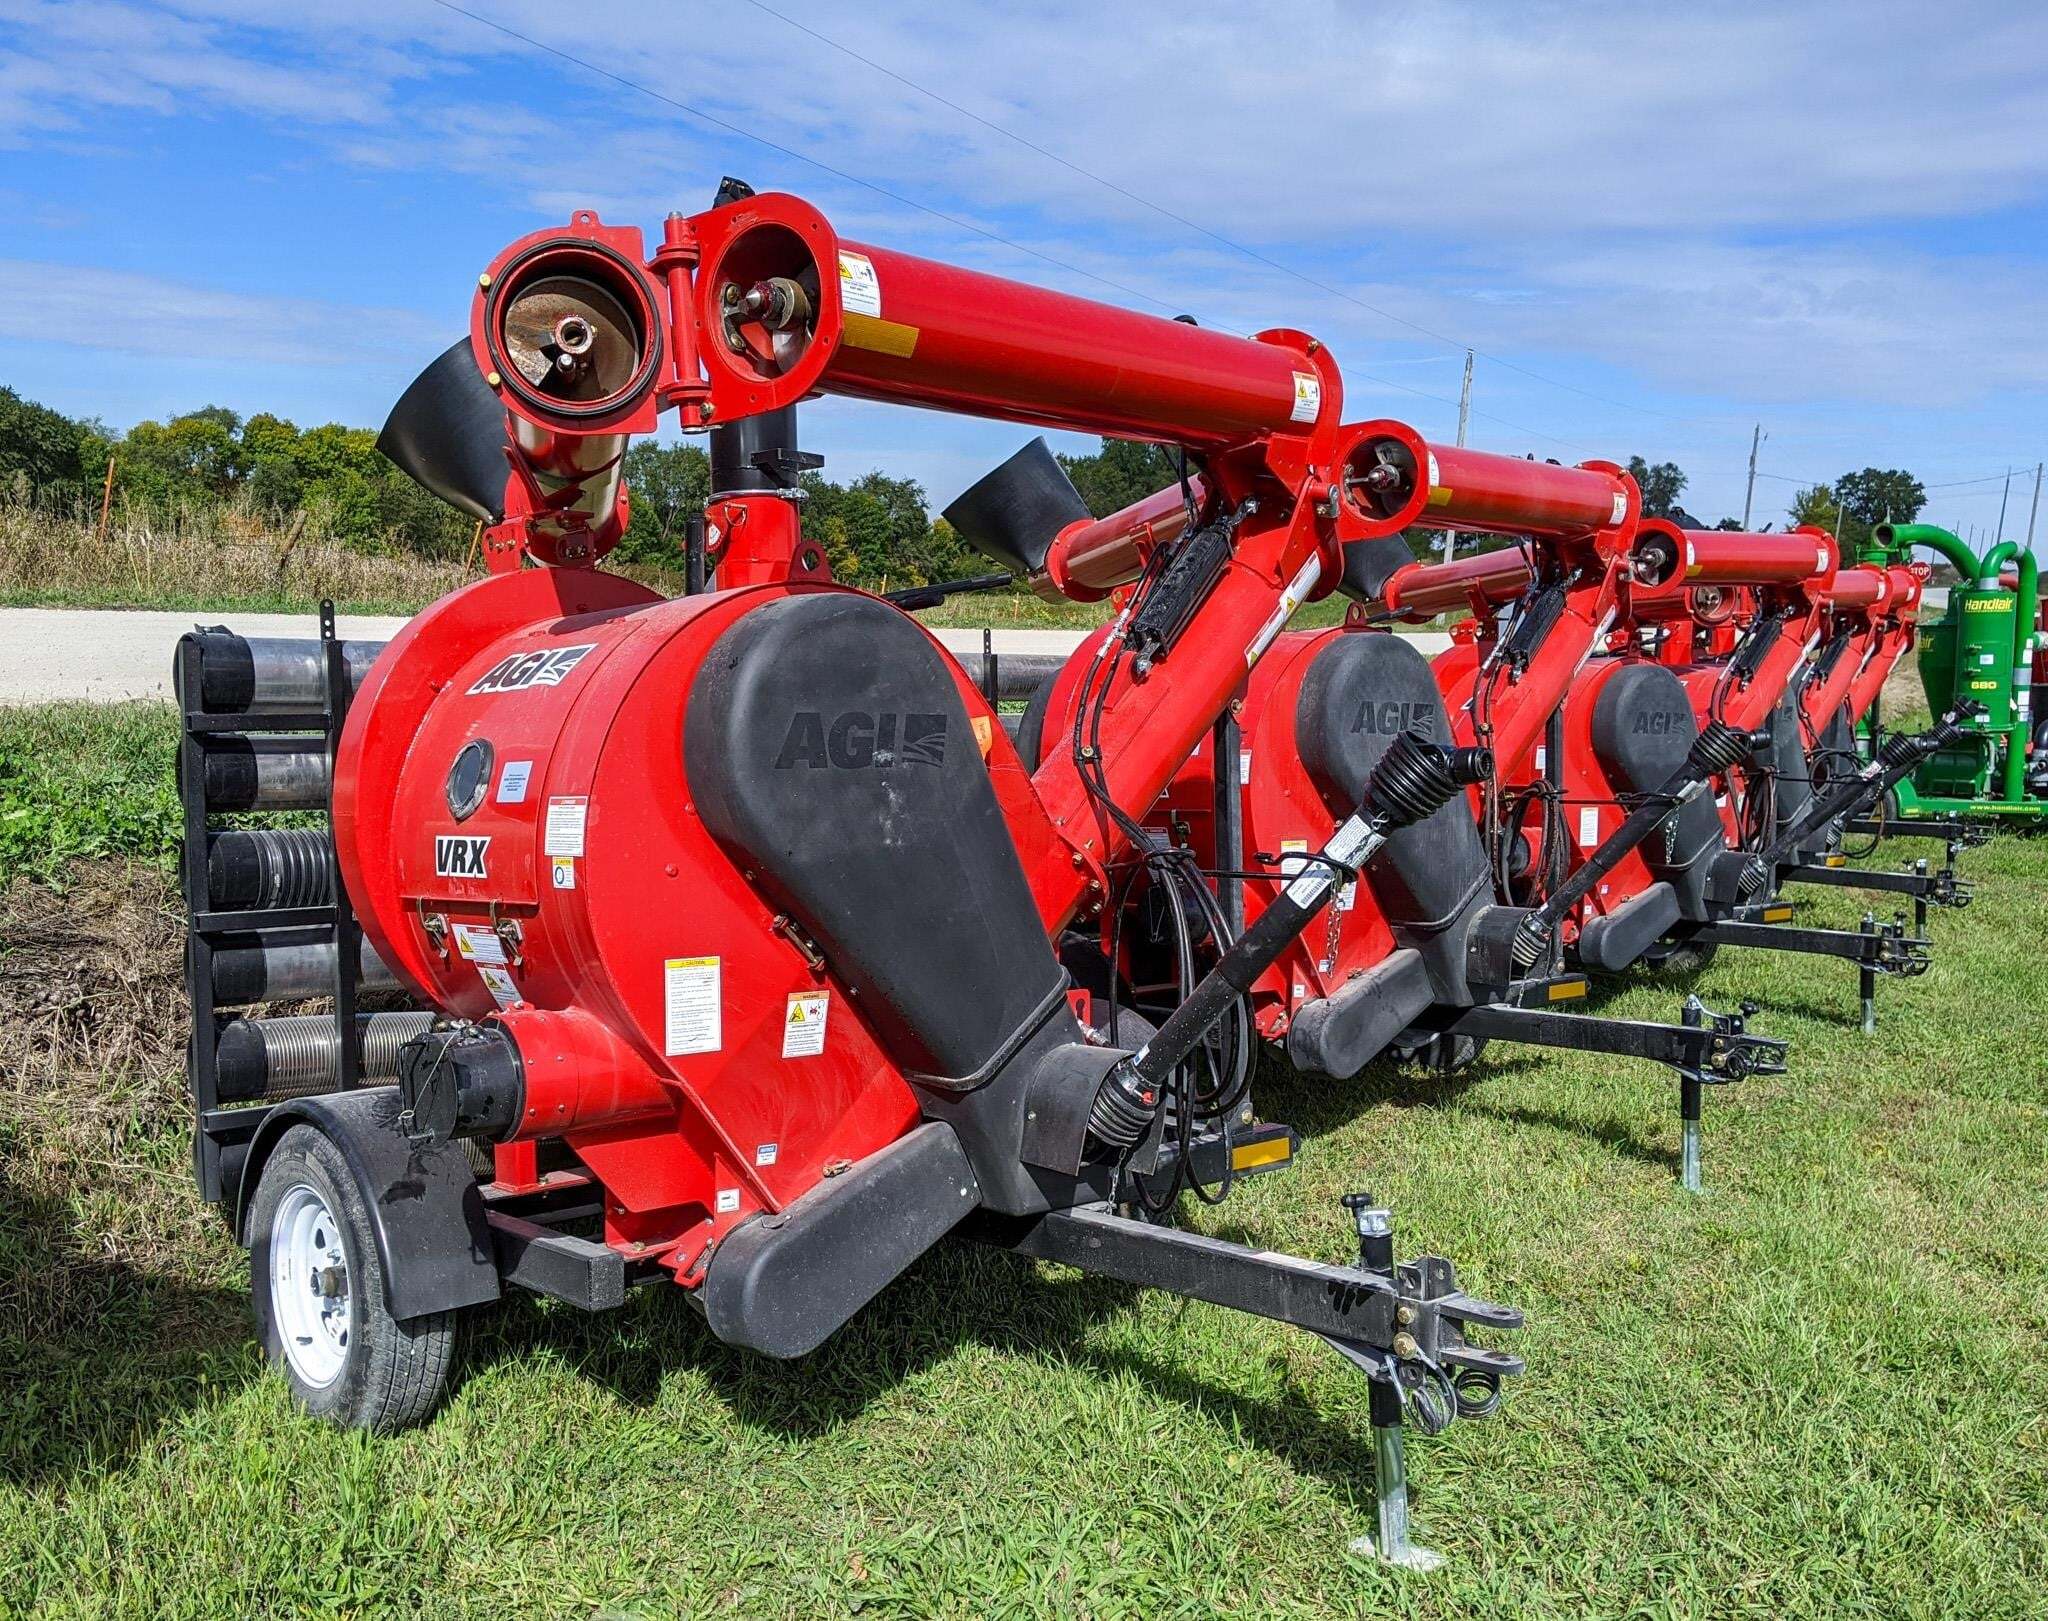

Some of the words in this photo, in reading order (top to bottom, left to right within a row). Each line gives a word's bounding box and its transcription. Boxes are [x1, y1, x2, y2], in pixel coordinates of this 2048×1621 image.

[1965, 597, 2013, 610] Handlair
[469, 648, 563, 692] AGI
[1350, 701, 1410, 735] AGI
[1632, 711, 1671, 735] AGI
[774, 711, 897, 769] AGI
[437, 839, 488, 874] VRX
